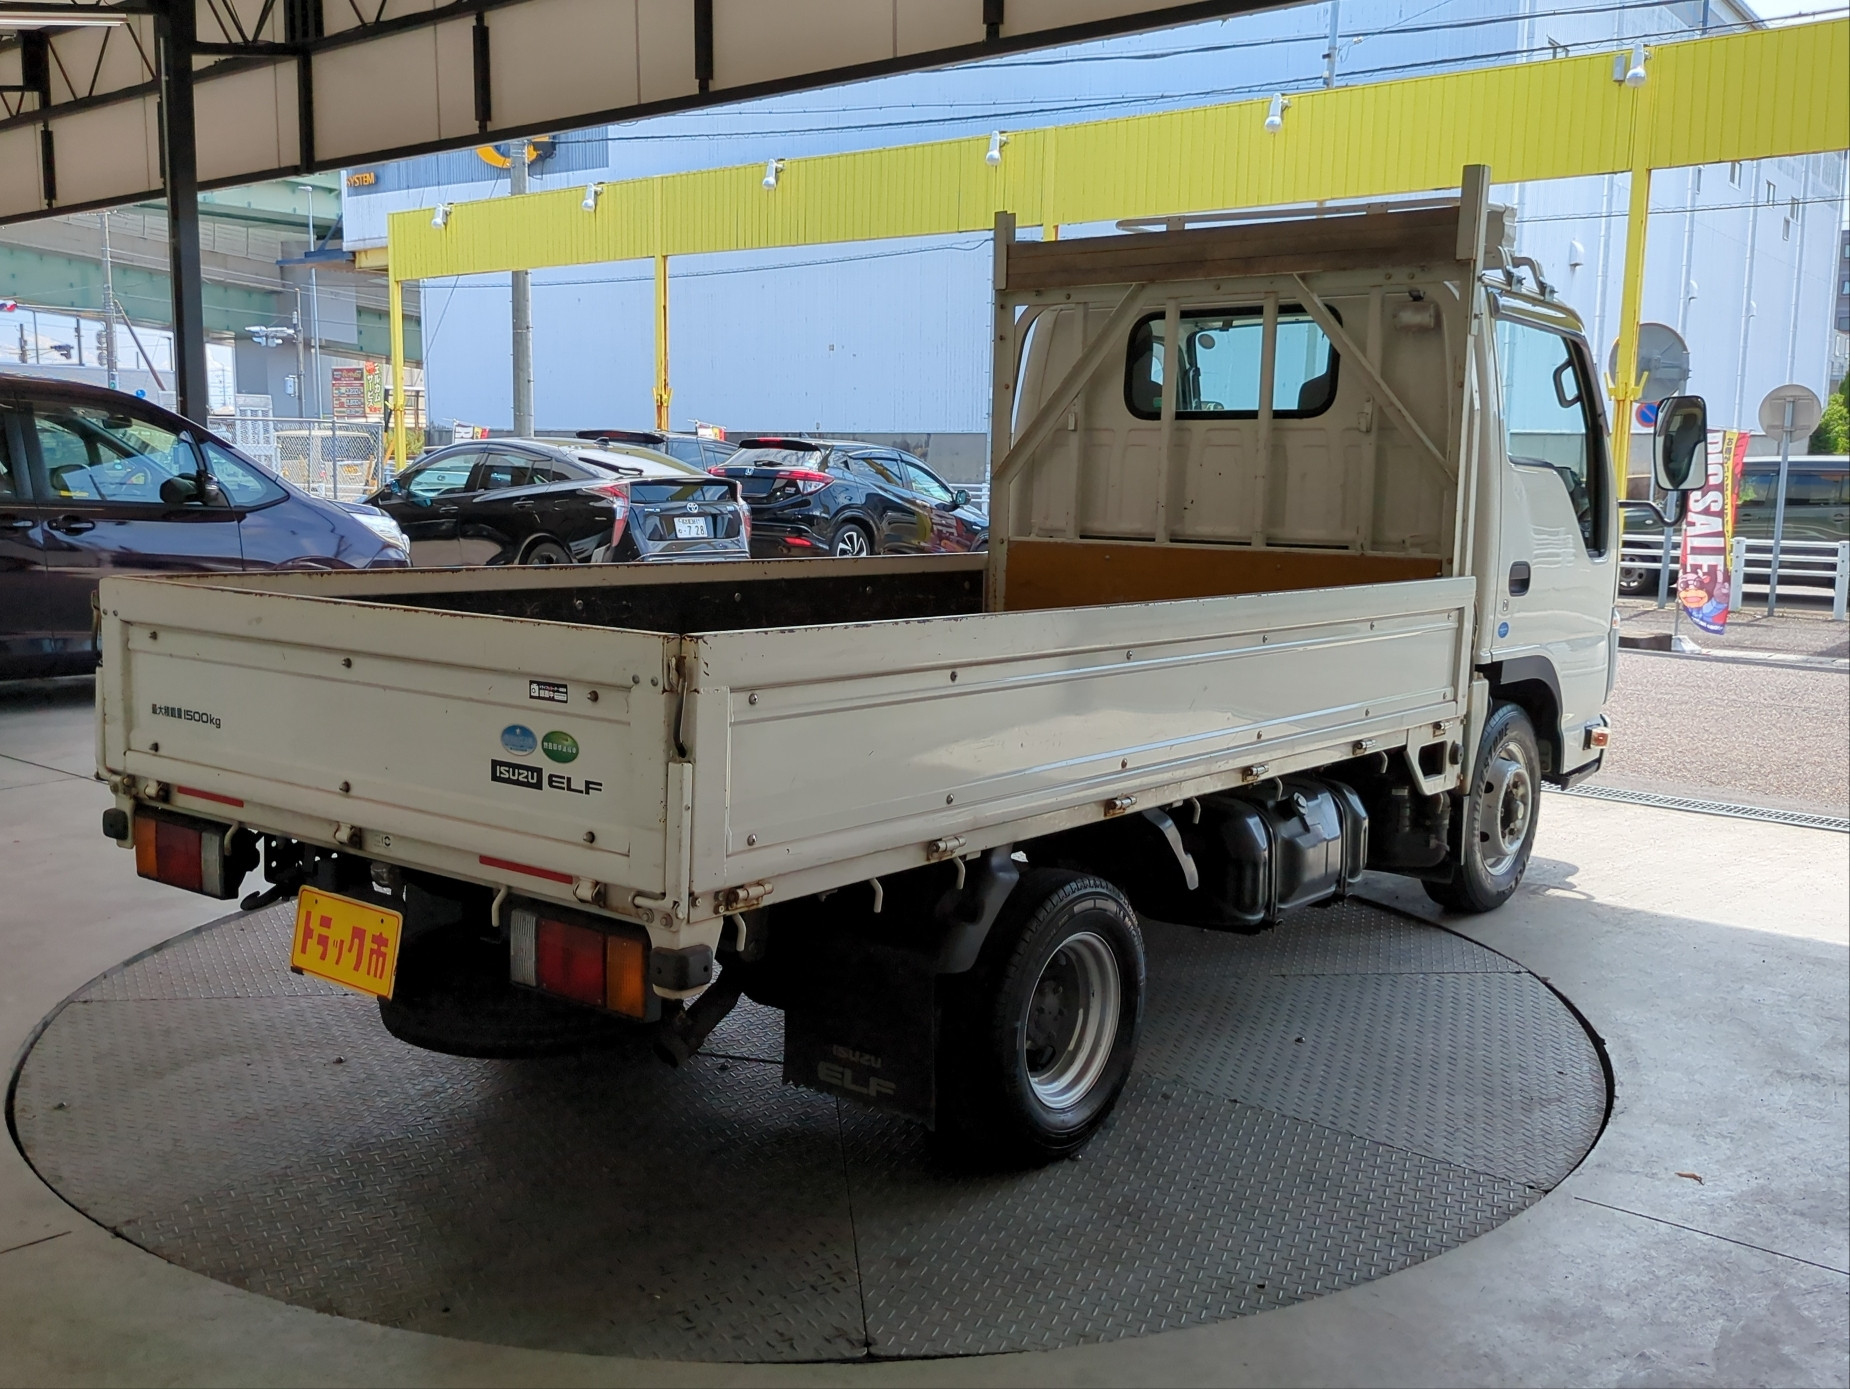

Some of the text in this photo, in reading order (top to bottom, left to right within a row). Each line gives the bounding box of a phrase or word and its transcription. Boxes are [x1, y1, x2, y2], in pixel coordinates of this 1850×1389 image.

[1687, 491, 1724, 573] SALE
[496, 765, 603, 795] ISUZU ELF
[300, 910, 389, 980] トラック市
[832, 1044, 882, 1069] ISUZU
[817, 1060, 897, 1097] ELF
